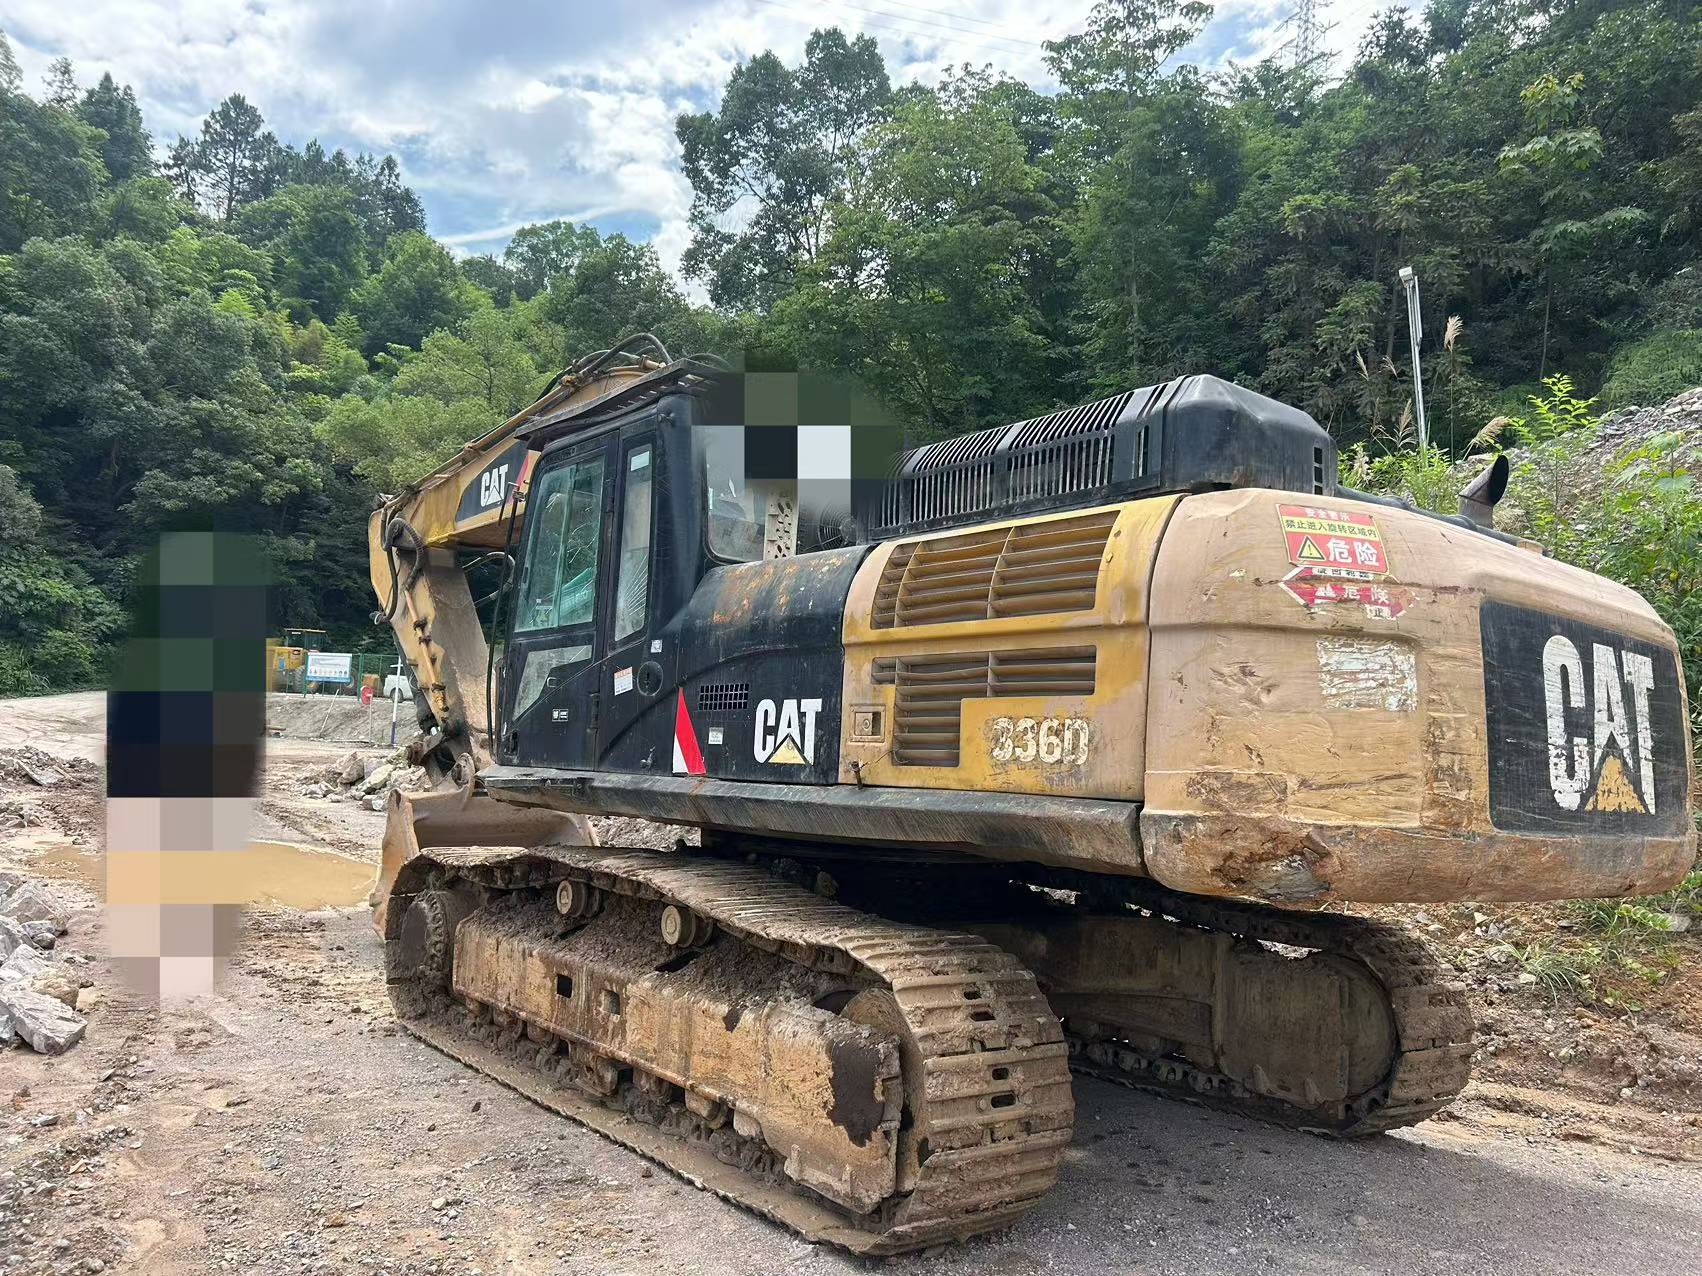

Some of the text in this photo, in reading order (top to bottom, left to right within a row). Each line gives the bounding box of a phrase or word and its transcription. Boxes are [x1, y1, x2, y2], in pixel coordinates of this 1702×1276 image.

[481, 463, 508, 507] CAT
[1285, 519, 1377, 538] 禁止进入旋转区域内
[1326, 537, 1380, 567] 危险
[754, 698, 823, 765] CAT
[991, 717, 1089, 765] 336D
[1542, 634, 1656, 815] CAT
